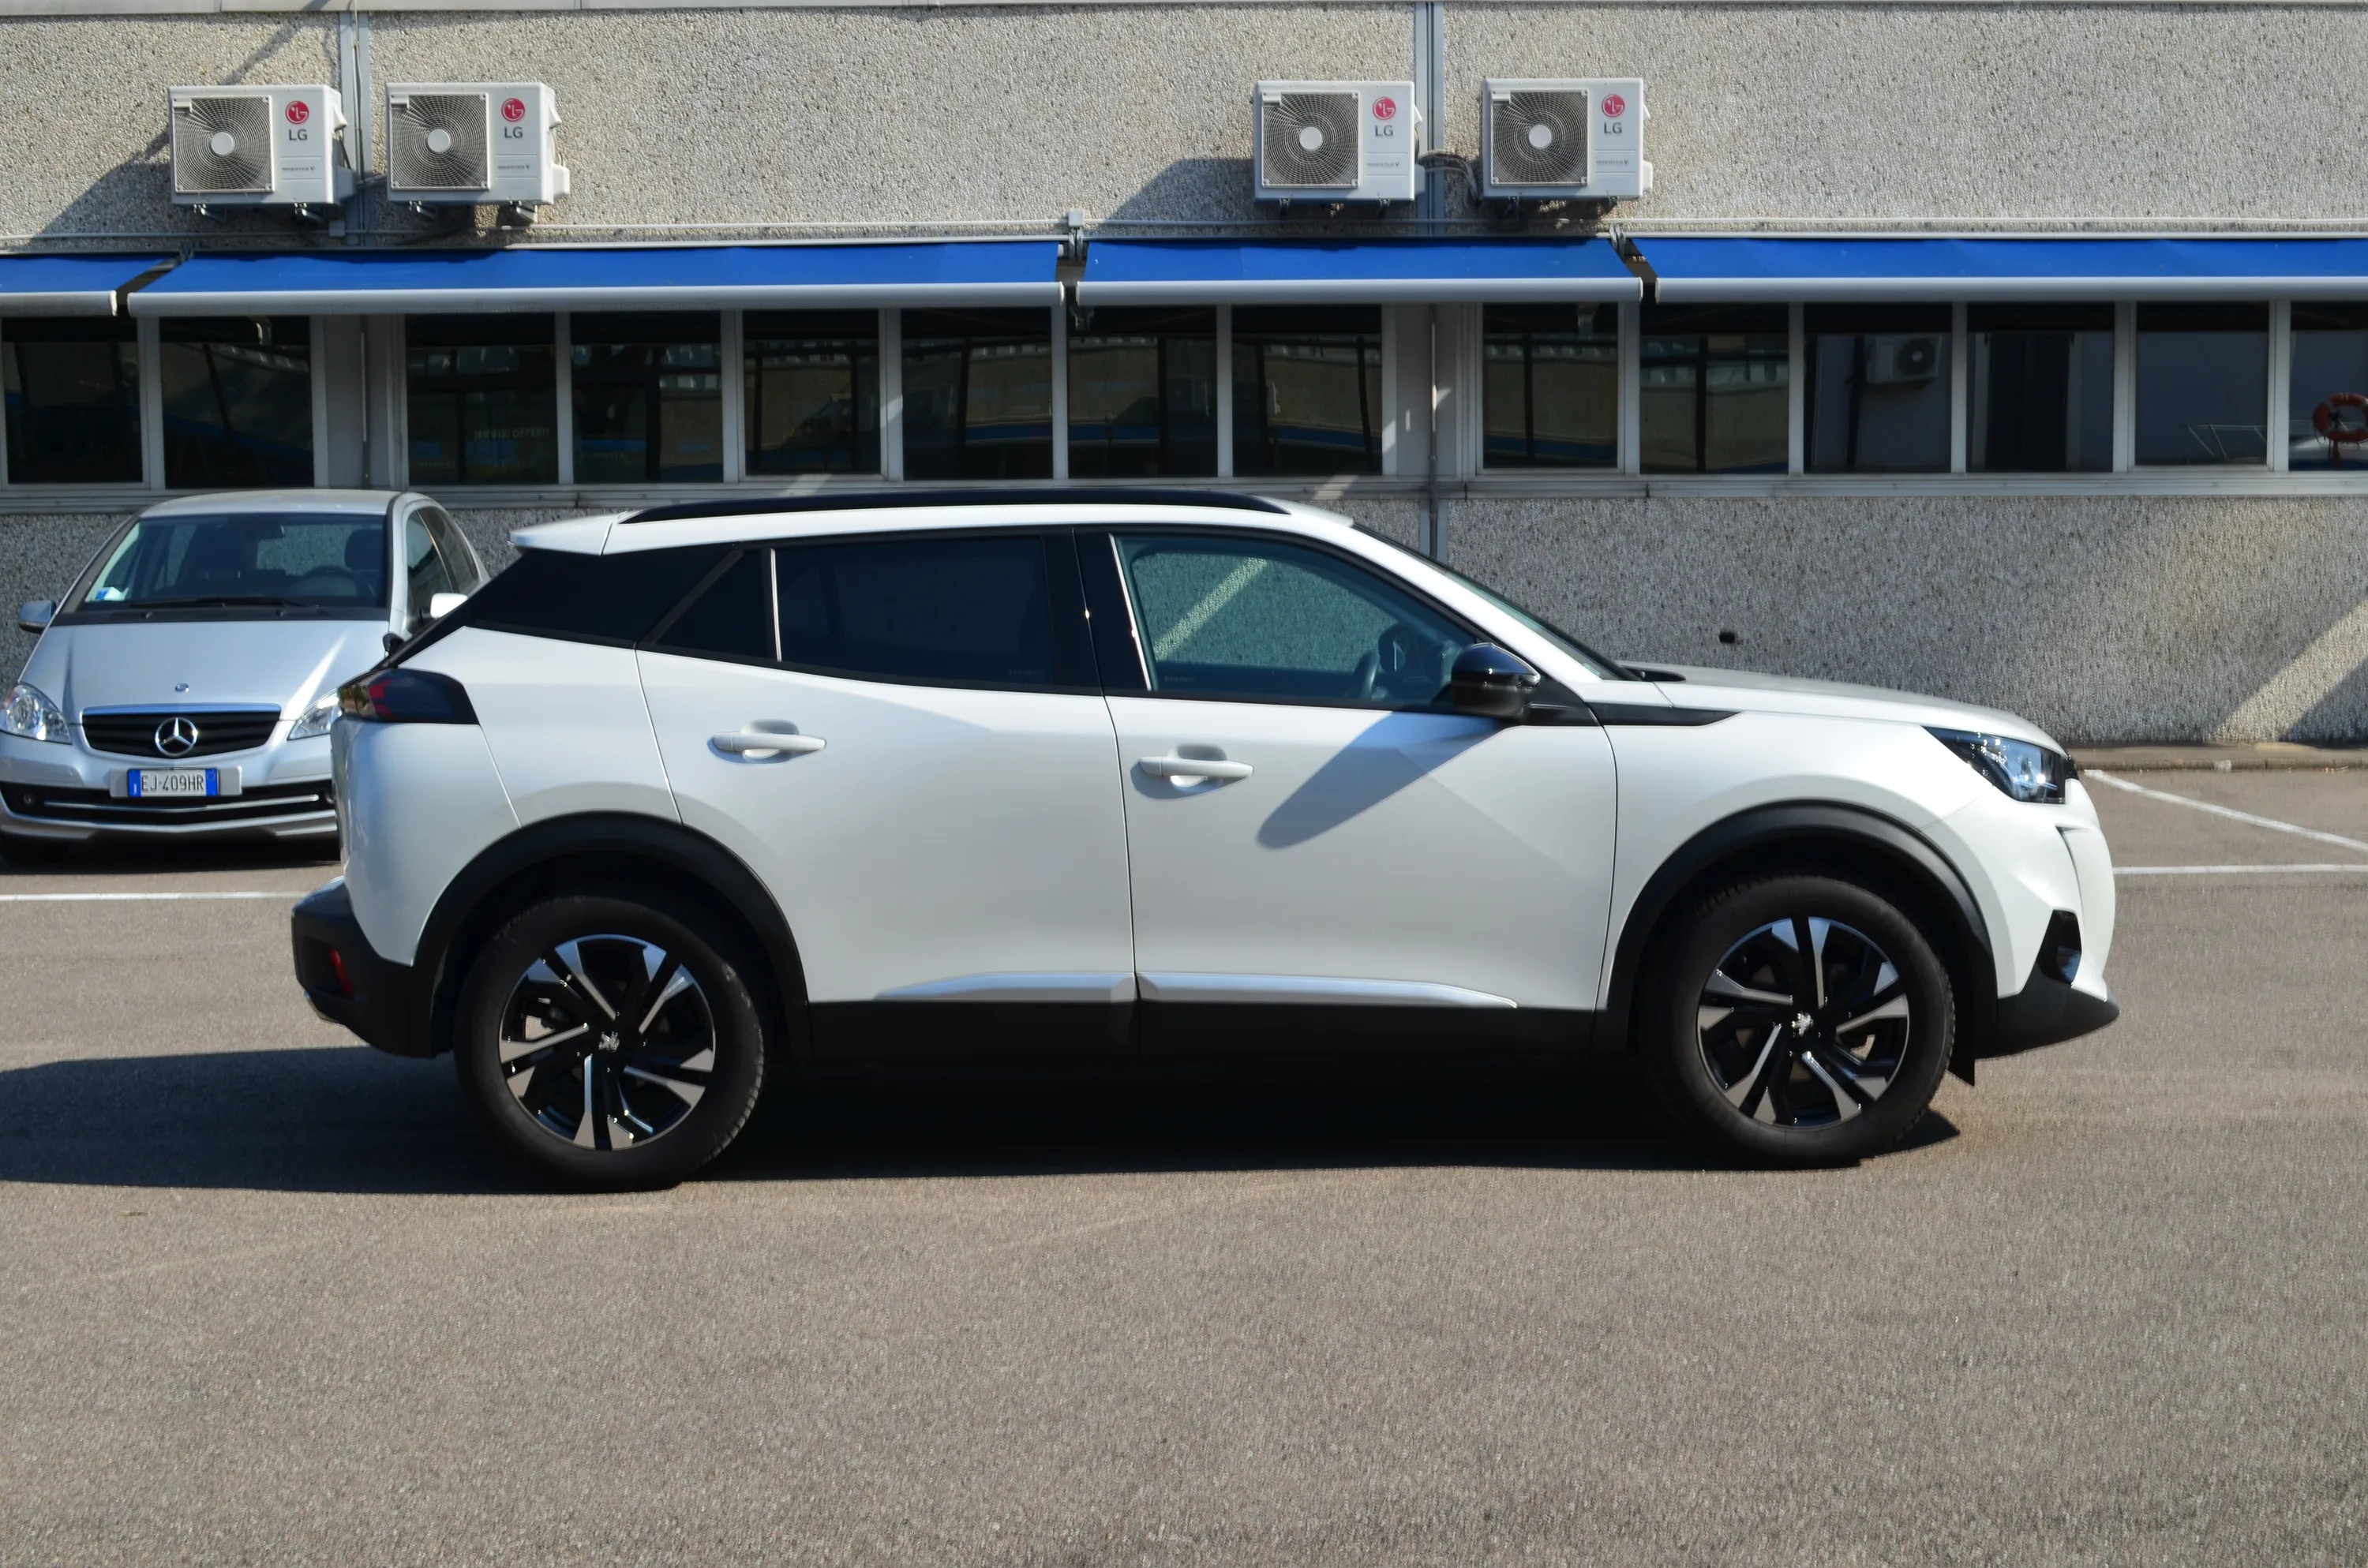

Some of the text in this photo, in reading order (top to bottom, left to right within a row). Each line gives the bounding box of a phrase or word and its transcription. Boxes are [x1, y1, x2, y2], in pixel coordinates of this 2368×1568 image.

[504, 126, 523, 139] LG
[1374, 125, 1394, 137] LG
[1603, 122, 1623, 134] LG
[288, 129, 308, 141] LG
